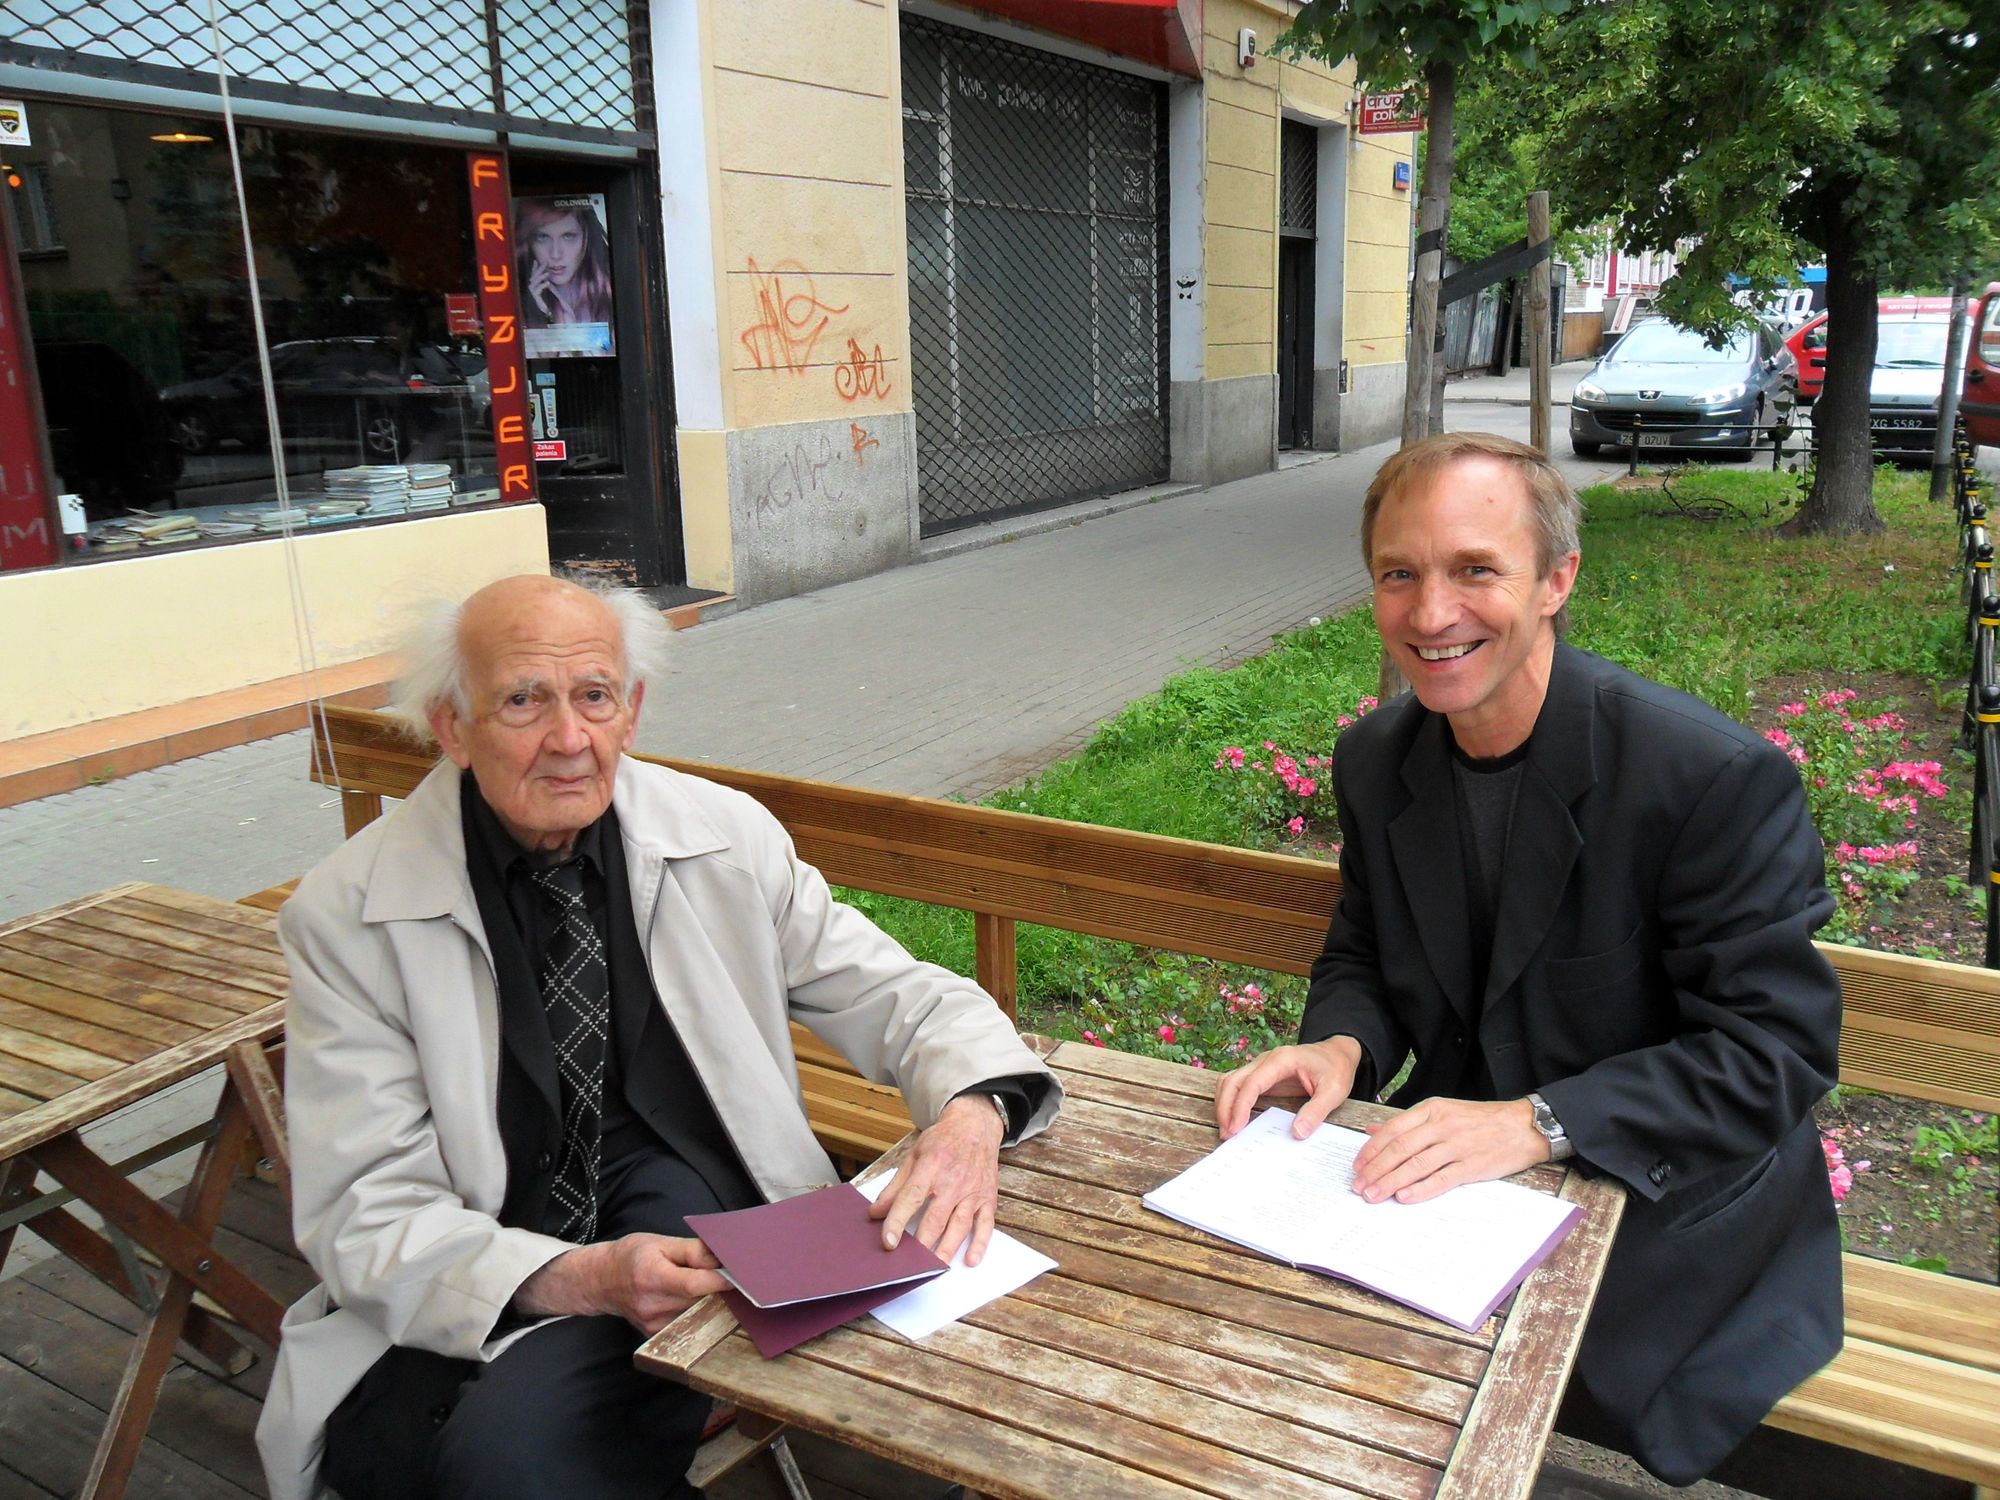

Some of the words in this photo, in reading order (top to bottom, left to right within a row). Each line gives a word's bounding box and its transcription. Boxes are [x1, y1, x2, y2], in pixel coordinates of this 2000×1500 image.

[472, 159, 529, 492] FRYZJER
[1893, 419, 1923, 429] 5582
[535, 450, 558, 458] palenia
